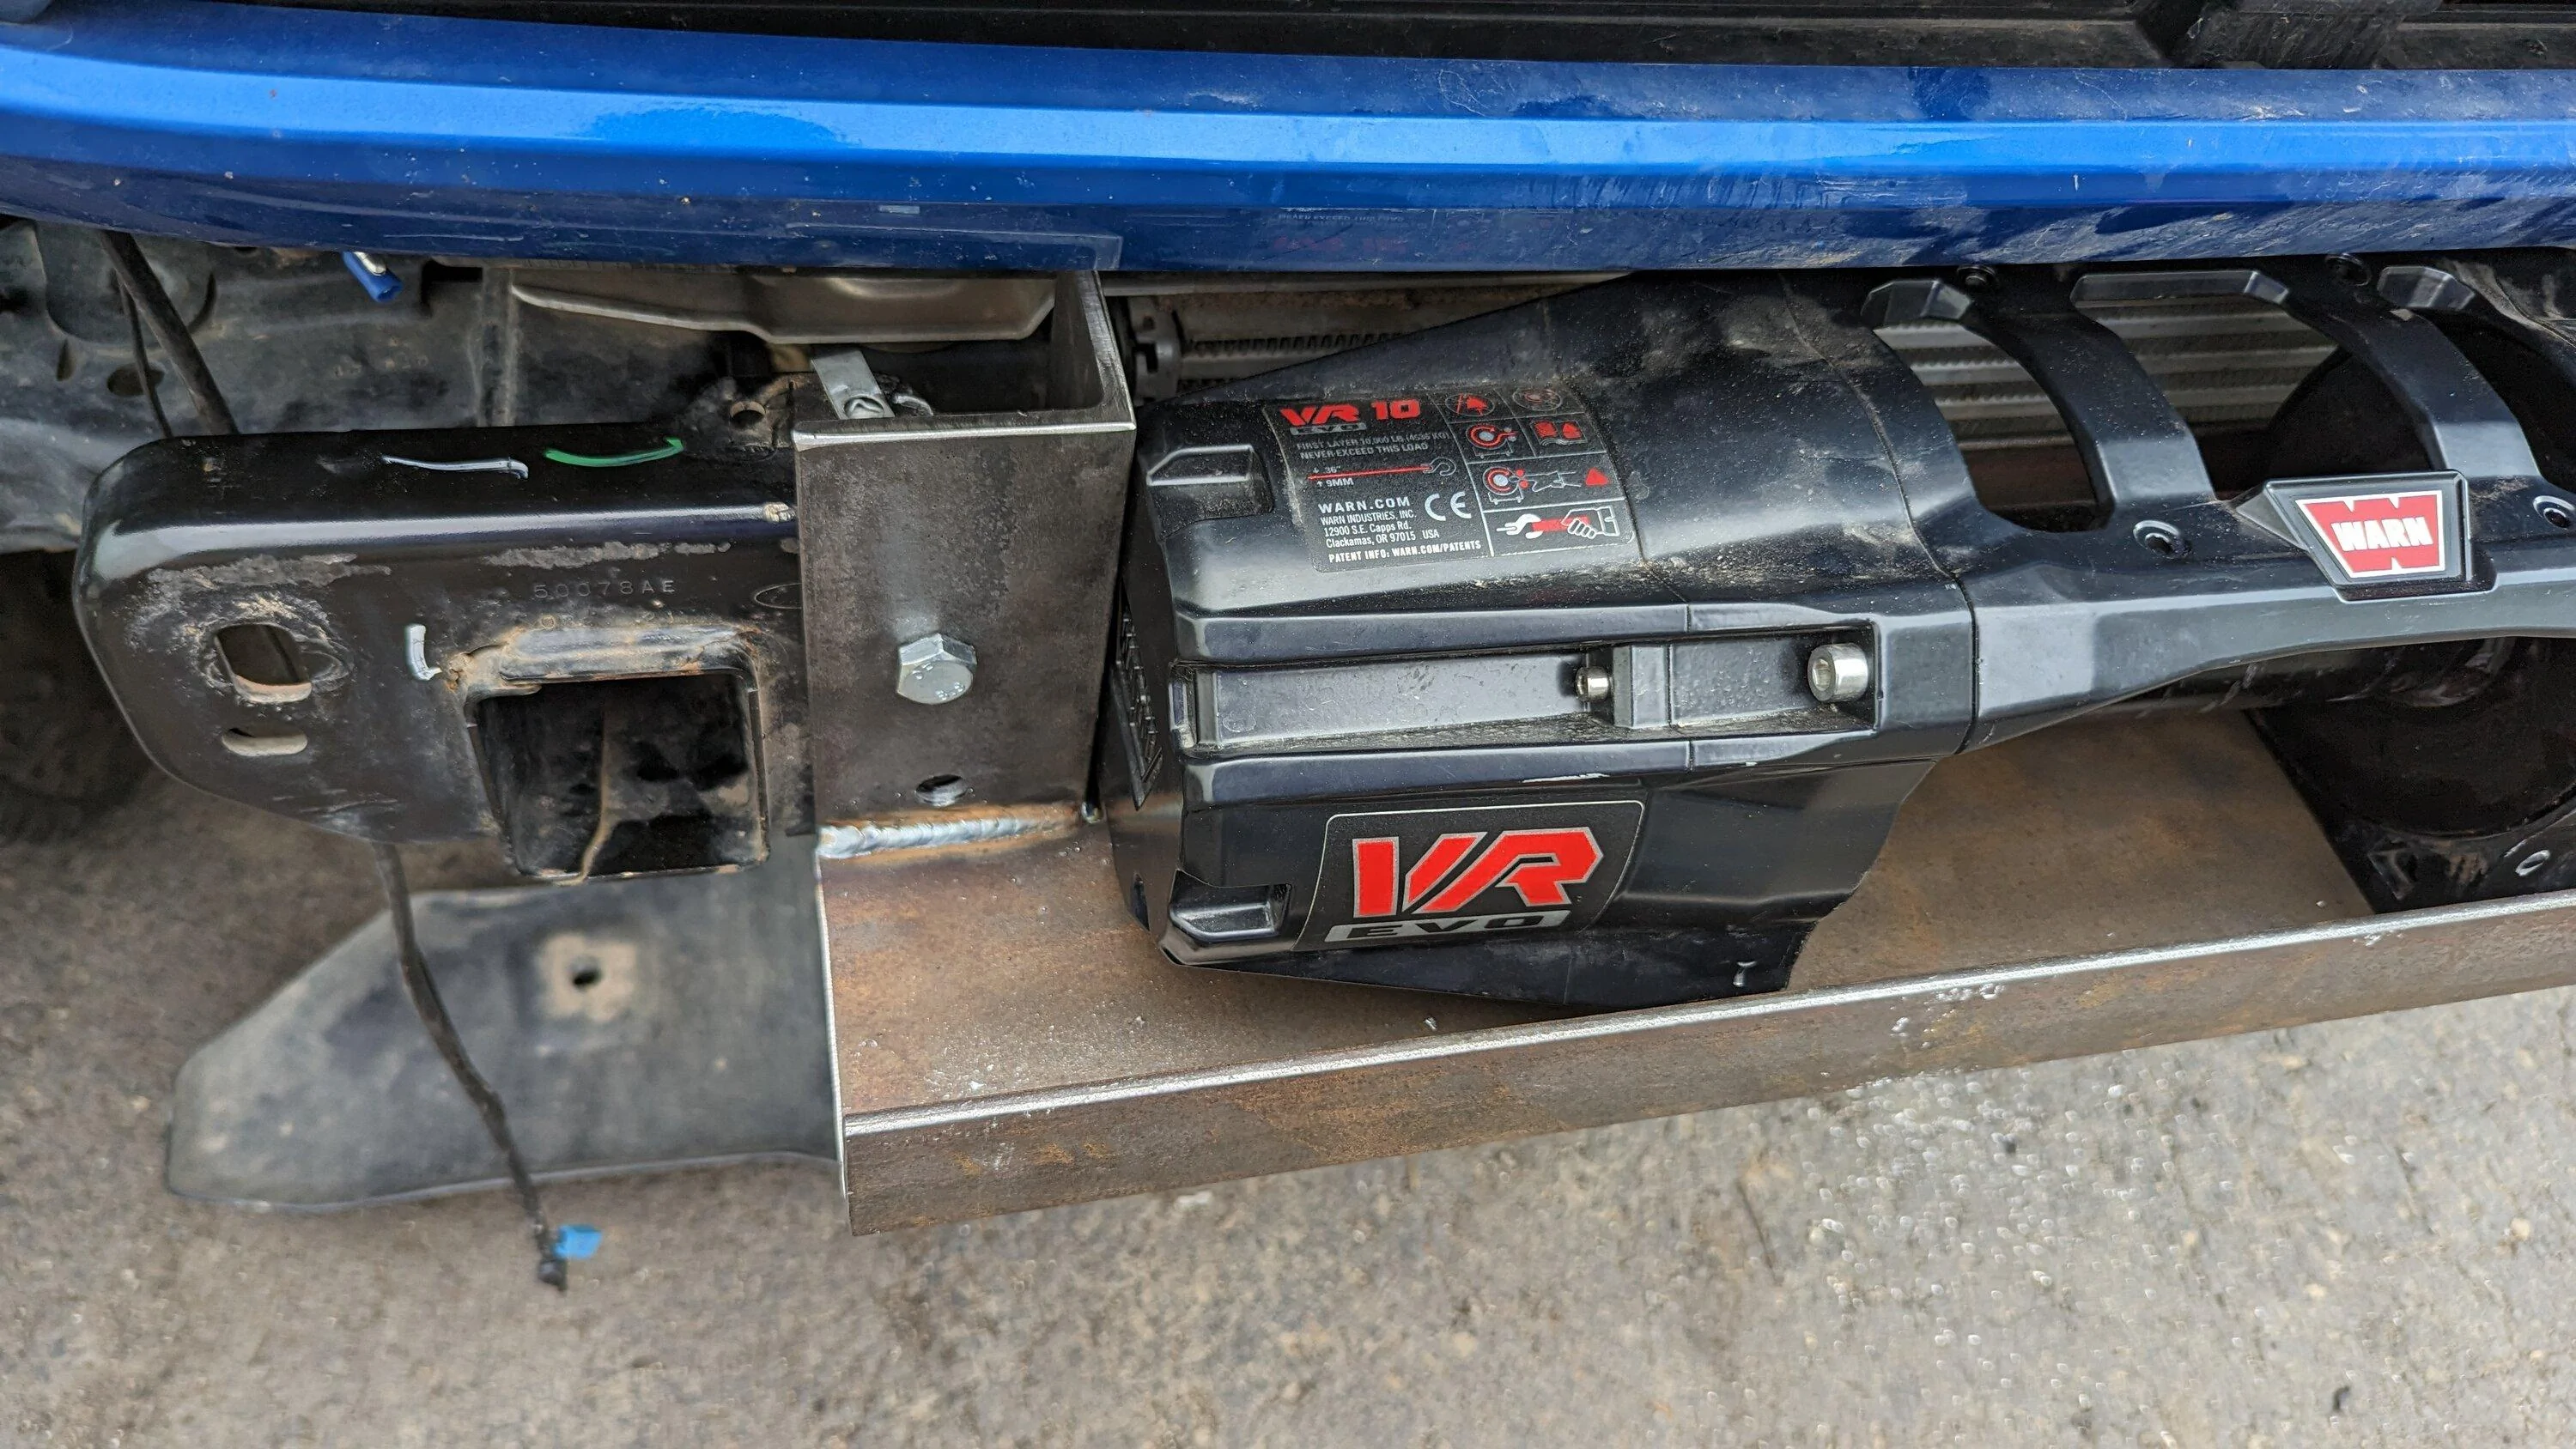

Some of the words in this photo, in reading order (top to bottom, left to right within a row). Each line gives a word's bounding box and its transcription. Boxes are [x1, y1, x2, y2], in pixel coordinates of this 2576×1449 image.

[1279, 403, 1359, 427] VR
[1370, 398, 1421, 421] 10
[1297, 440, 1324, 450] FIRST
[1327, 438, 1358, 448] LAYER
[1360, 435, 1389, 446] 10,000
[1299, 450, 1334, 460] NEVER
[1336, 446, 1374, 457] EXCEED
[1376, 445, 1400, 454] THIS
[1401, 442, 1429, 452] LOAD
[1325, 477, 1355, 488] 9MM
[1317, 496, 1411, 514] WARN.COM
[1424, 491, 1473, 522] CE
[1320, 514, 1346, 526] WARN
[1346, 511, 1398, 524] INDUSTRIES,
[1399, 509, 1418, 519] INC.
[1323, 525, 1350, 537] 12900
[1351, 524, 1369, 535] S.E.
[1369, 522, 1396, 534] Capps
[1396, 520, 1413, 530] Rd.
[2330, 516, 2433, 552] WARN
[1326, 537, 1375, 549] Clackamas,
[1376, 533, 1389, 544] OR
[1388, 530, 1417, 543] 97015
[1421, 529, 1440, 539] USA
[1328, 550, 1362, 563] PATENT
[1364, 549, 1390, 560] INFO:
[1391, 539, 1482, 557] WARN.COM/PATENTS
[1352, 826, 1605, 919] VR
[1346, 914, 1547, 940] EVO
